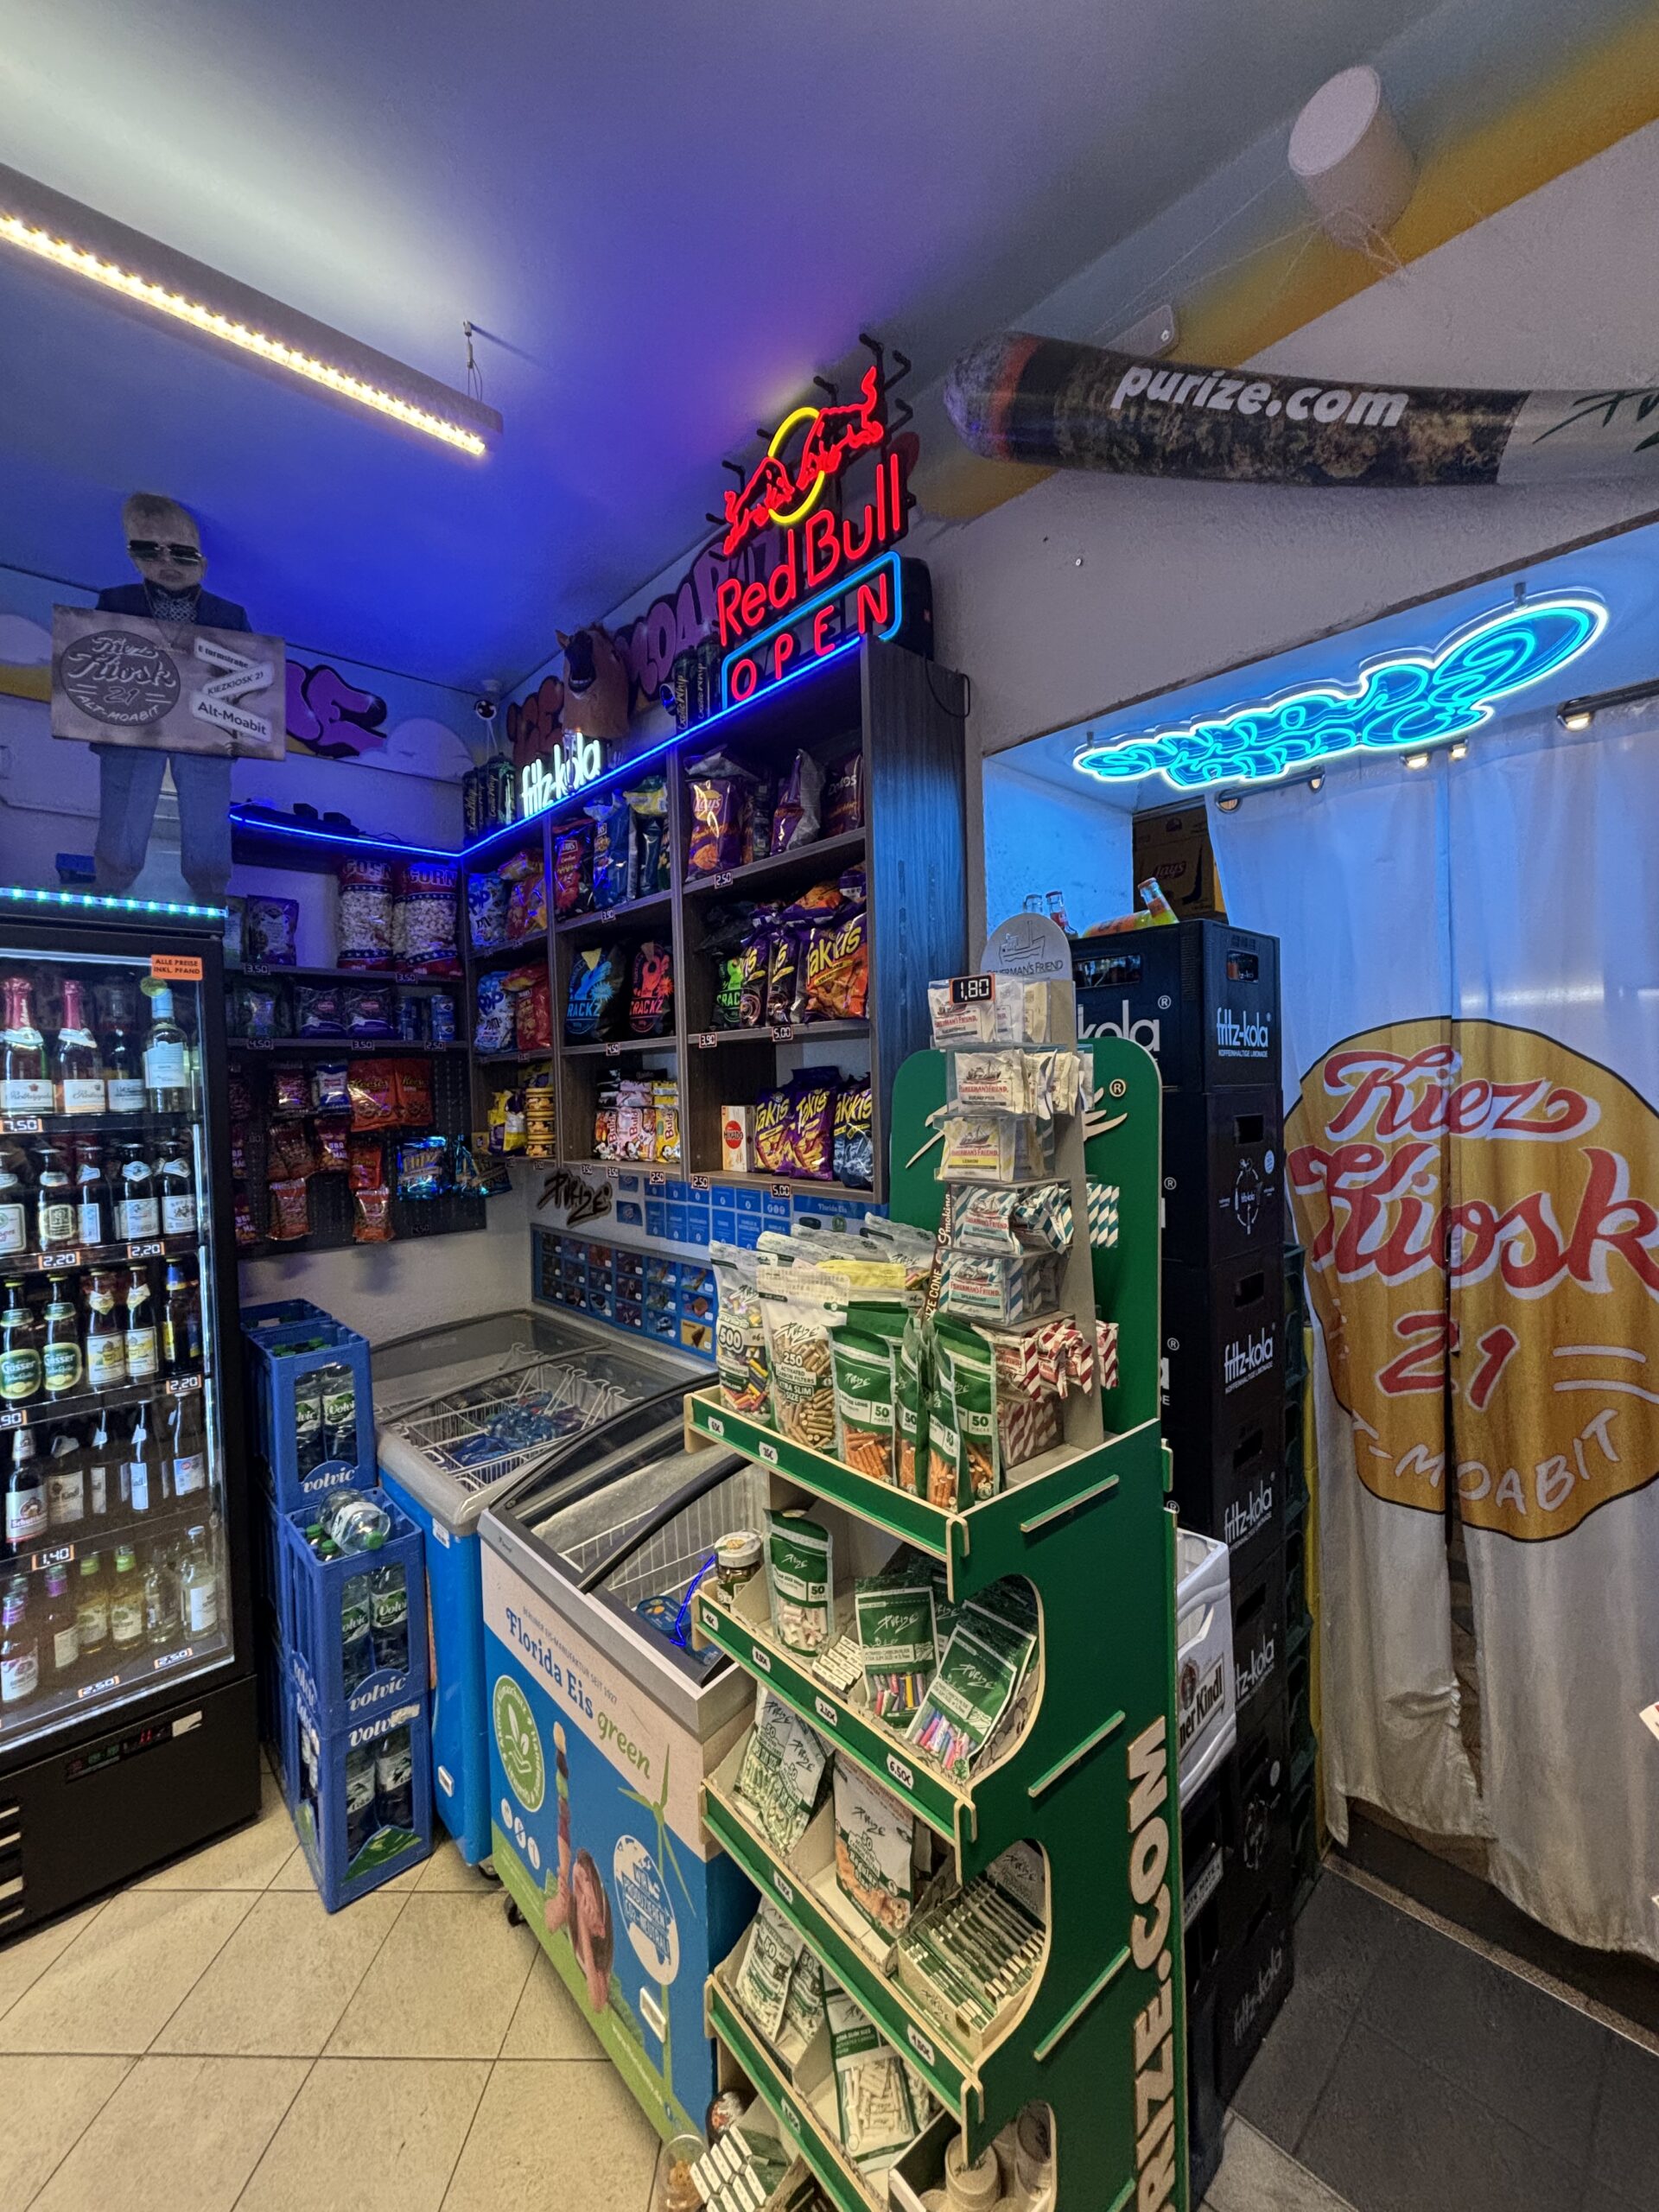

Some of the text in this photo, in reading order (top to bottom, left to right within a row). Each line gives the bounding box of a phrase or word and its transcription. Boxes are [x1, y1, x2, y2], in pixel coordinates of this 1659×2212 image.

[1109, 364, 1412, 429] purize.com
[717, 453, 901, 647] Red Bull
[731, 572, 889, 702] OPEN
[77, 695, 161, 722] ALT-MOABIT
[198, 701, 267, 735] Alt-Moabit
[521, 732, 602, 818] fritz-kola
[1035, 959, 1064, 973] FRIEND
[1216, 1007, 1269, 1048] fritz-kola
[1323, 1044, 1601, 1143] Kiez
[3, 1120, 38, 1132] 7.50
[1286, 1141, 1659, 1300] Kiosk
[42, 1254, 76, 1268] 2.20
[132, 1243, 161, 1258] 2.20
[718, 1325, 744, 1354] 500
[782, 1351, 803, 1367] 250
[1224, 1326, 1273, 1384] fritz-kola
[1376, 1310, 1521, 1413] 21
[169, 1376, 198, 1392] 2.20
[785, 1391, 799, 1402] SIZE
[793, 1385, 812, 1395] SLIM
[874, 1405, 890, 1418] 50
[971, 1415, 989, 1427] 50
[302, 1466, 356, 1493] volvic
[1224, 1479, 1273, 1544] fritz-kola
[41, 1547, 70, 1567] 1.40
[810, 1585, 825, 1595] 50
[349, 1675, 407, 1712] volvic
[505, 1605, 563, 1688] Florida
[566, 1669, 594, 1720] Eis
[597, 1711, 651, 1780] green
[1196, 1664, 1224, 1726] Kindl
